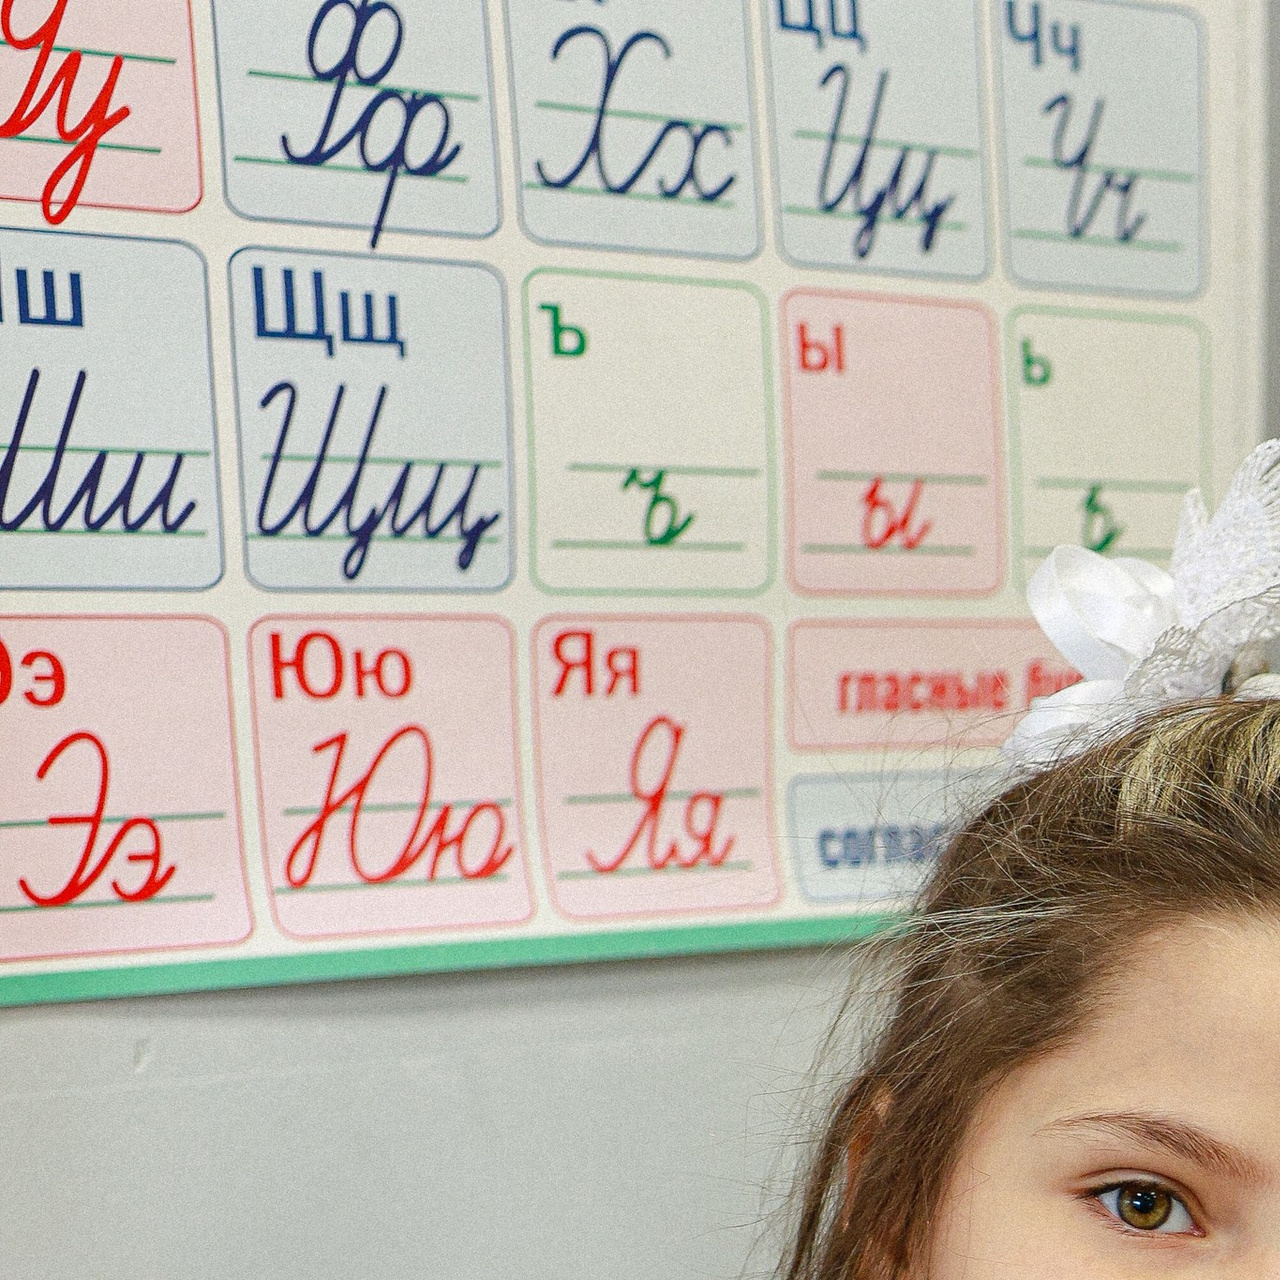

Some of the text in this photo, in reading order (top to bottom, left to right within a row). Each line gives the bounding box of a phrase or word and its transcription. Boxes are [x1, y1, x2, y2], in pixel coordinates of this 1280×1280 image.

[536, 25, 736, 200] Хх
[0, 267, 84, 328] ш
[252, 265, 406, 360] Щщ
[258, 382, 501, 580] Щщ
[269, 630, 412, 700] Юю
[551, 629, 639, 697] Яя
[18, 729, 177, 909] Ээ
[285, 722, 515, 890] Юю
[585, 714, 738, 874] Яя
